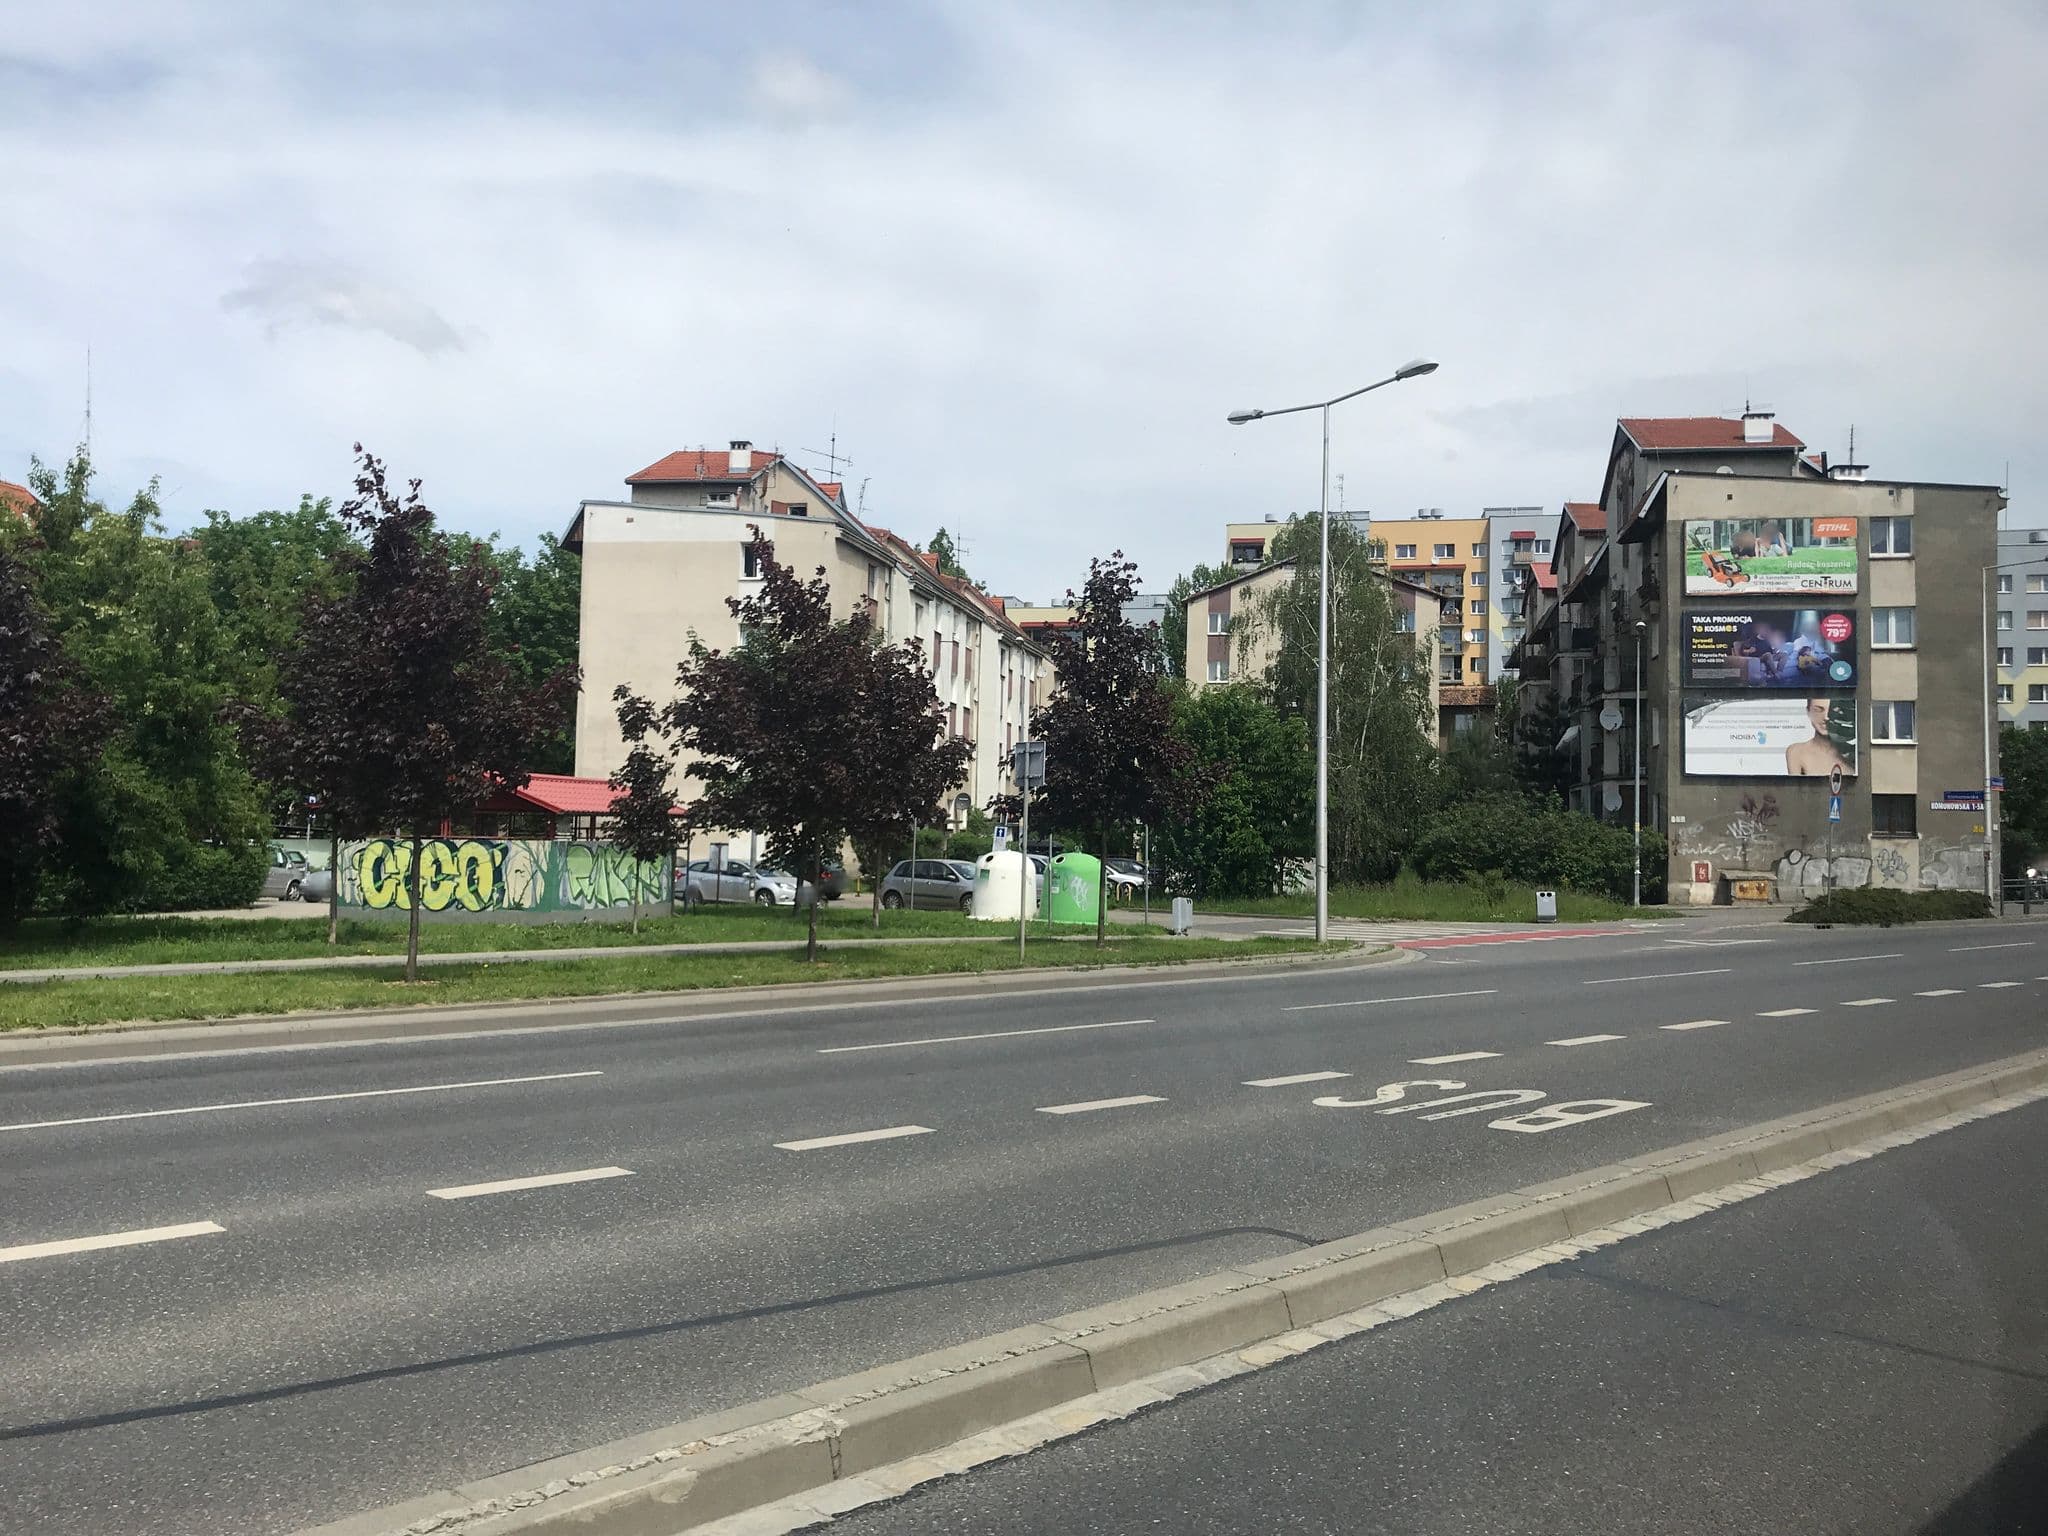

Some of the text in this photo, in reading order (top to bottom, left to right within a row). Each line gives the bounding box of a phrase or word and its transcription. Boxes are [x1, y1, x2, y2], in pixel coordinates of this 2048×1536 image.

[1817, 523, 1850, 532] STIHL
[1801, 575, 1852, 588] CENTRUM
[1712, 616, 1752, 624] PROMOCJA
[1312, 1080, 1653, 1133] BUS
